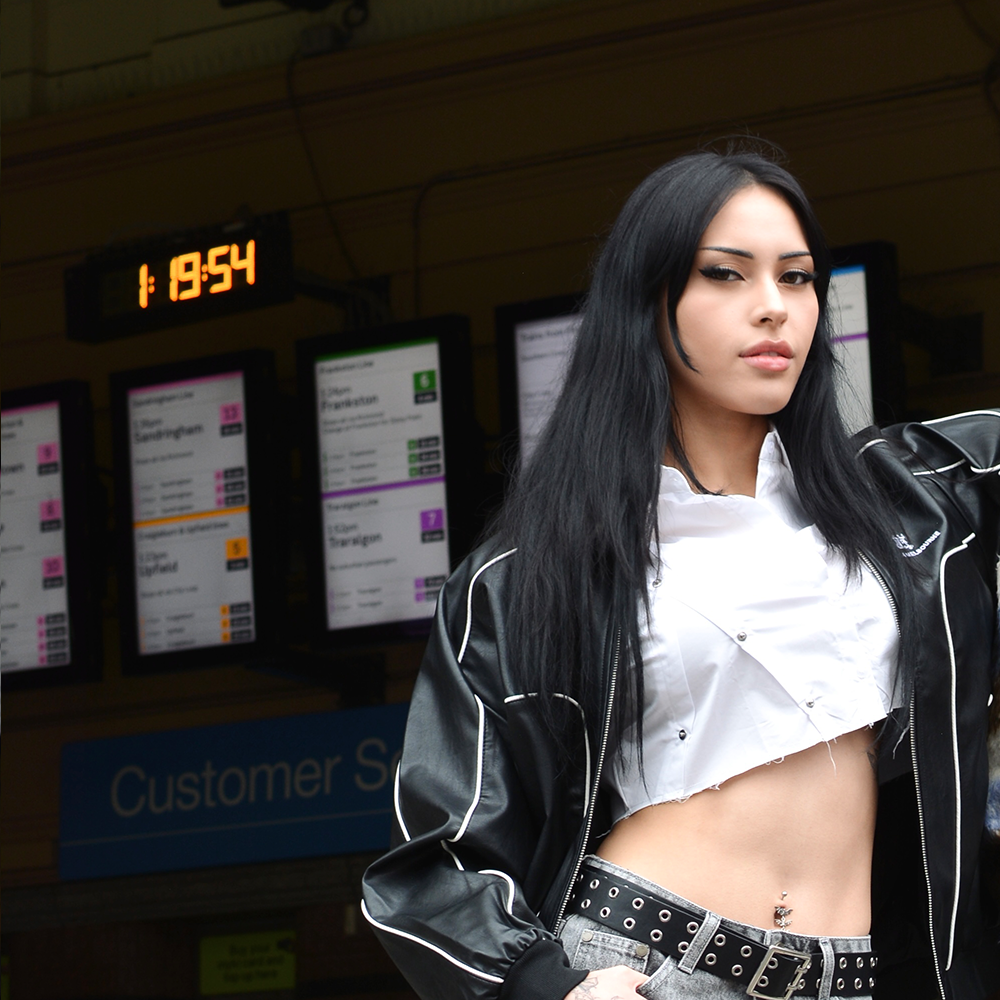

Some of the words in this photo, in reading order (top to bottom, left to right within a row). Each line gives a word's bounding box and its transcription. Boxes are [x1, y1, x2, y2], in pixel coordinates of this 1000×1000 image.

[420, 373, 429, 388] 6
[134, 424, 204, 443] Sandringham
[427, 512, 437, 527] 7
[110, 754, 342, 818] Customer
